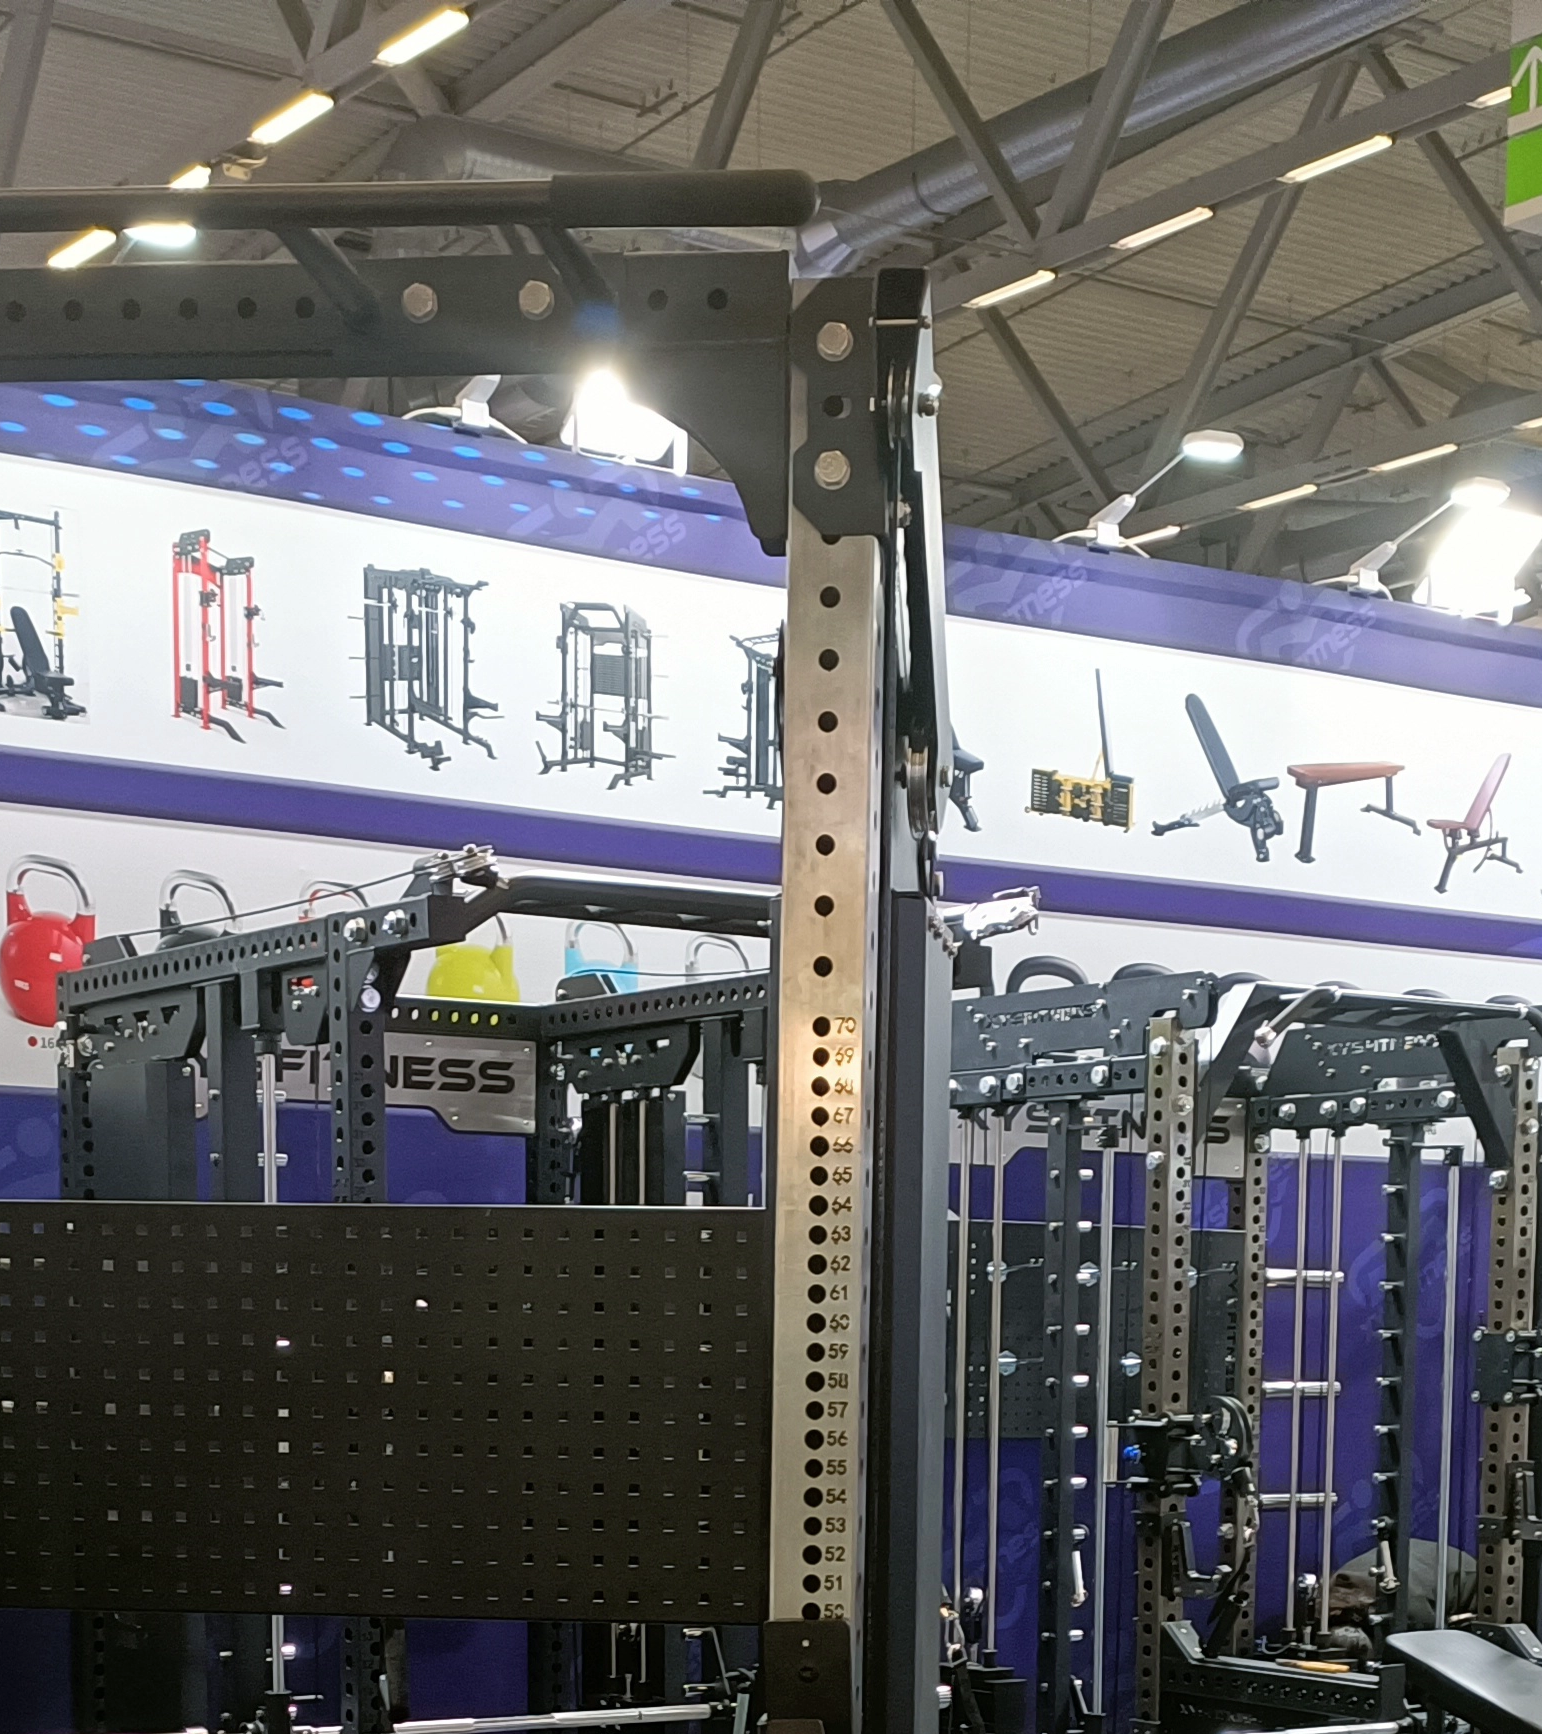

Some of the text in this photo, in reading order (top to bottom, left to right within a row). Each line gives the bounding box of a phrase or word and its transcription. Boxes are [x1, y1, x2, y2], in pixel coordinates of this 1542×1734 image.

[834, 1017, 857, 1034] 70
[40, 1037, 56, 1049] 16
[835, 1047, 854, 1066] 69
[833, 1107, 854, 1125] 67
[832, 1137, 853, 1154] 66
[832, 1167, 852, 1185] 65
[832, 1197, 852, 1215] 64
[831, 1226, 851, 1245] 63
[831, 1255, 850, 1274] 62
[830, 1285, 847, 1300] 61
[829, 1314, 849, 1333] 60
[828, 1344, 848, 1359] 59
[828, 1373, 848, 1389] 58
[828, 1402, 848, 1418] 57
[827, 1431, 848, 1446] 56
[826, 1460, 847, 1475] 55
[826, 1489, 847, 1504] 54
[825, 1517, 846, 1533] 53
[825, 1546, 845, 1562] 52
[824, 1575, 842, 1591] 51
[824, 1604, 844, 1618] 50
